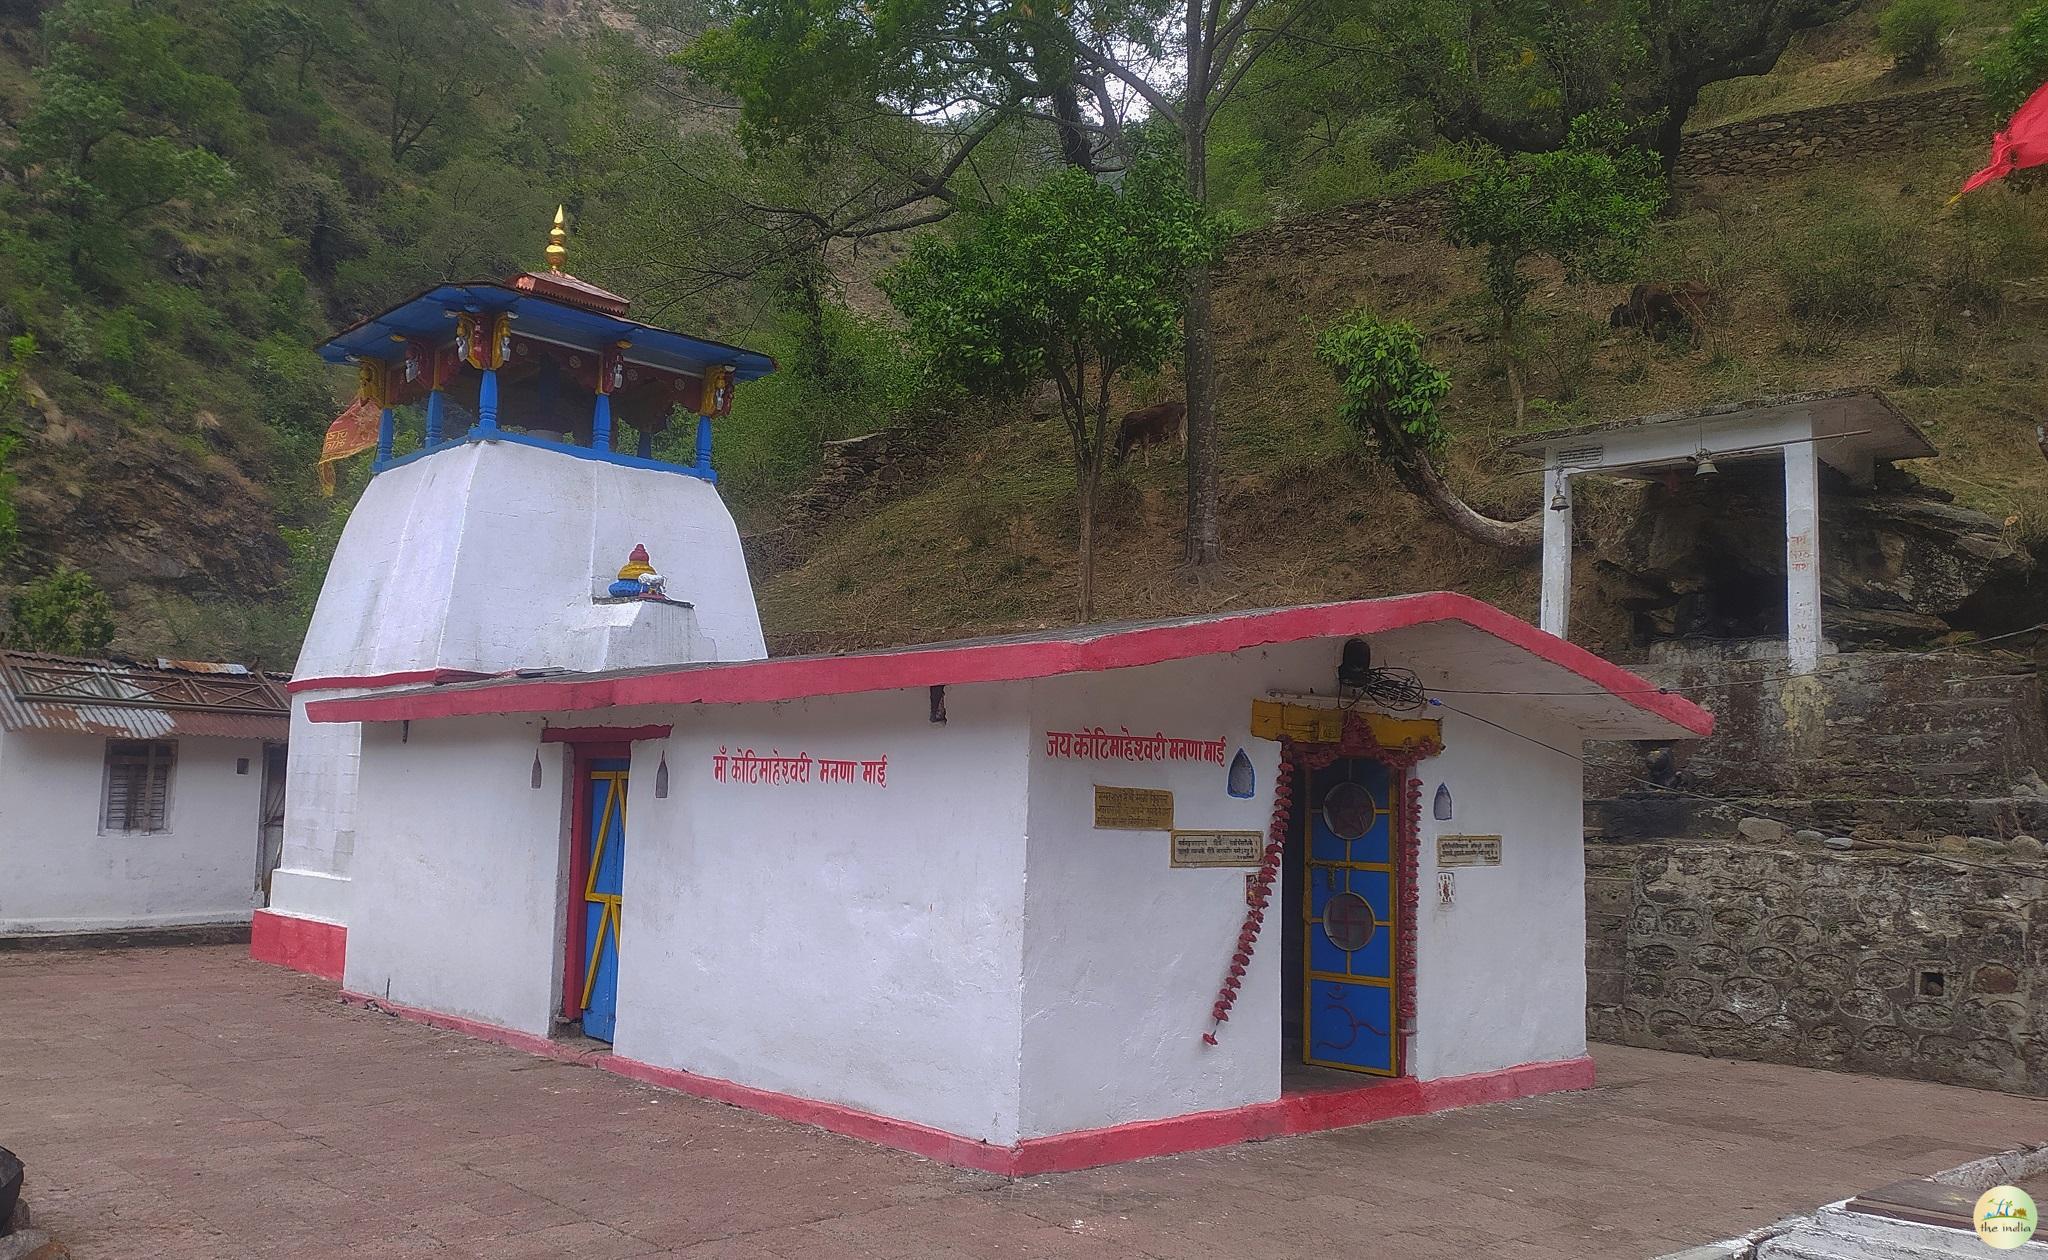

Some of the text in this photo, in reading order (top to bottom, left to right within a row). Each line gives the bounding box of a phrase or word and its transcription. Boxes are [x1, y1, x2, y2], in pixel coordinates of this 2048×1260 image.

[713, 745, 729, 785] माँ
[818, 759, 857, 784] मनणा
[861, 753, 888, 789] माई
[1046, 731, 1074, 758] जय
[1167, 737, 1203, 761] मनणा
[1203, 735, 1226, 767] माई
